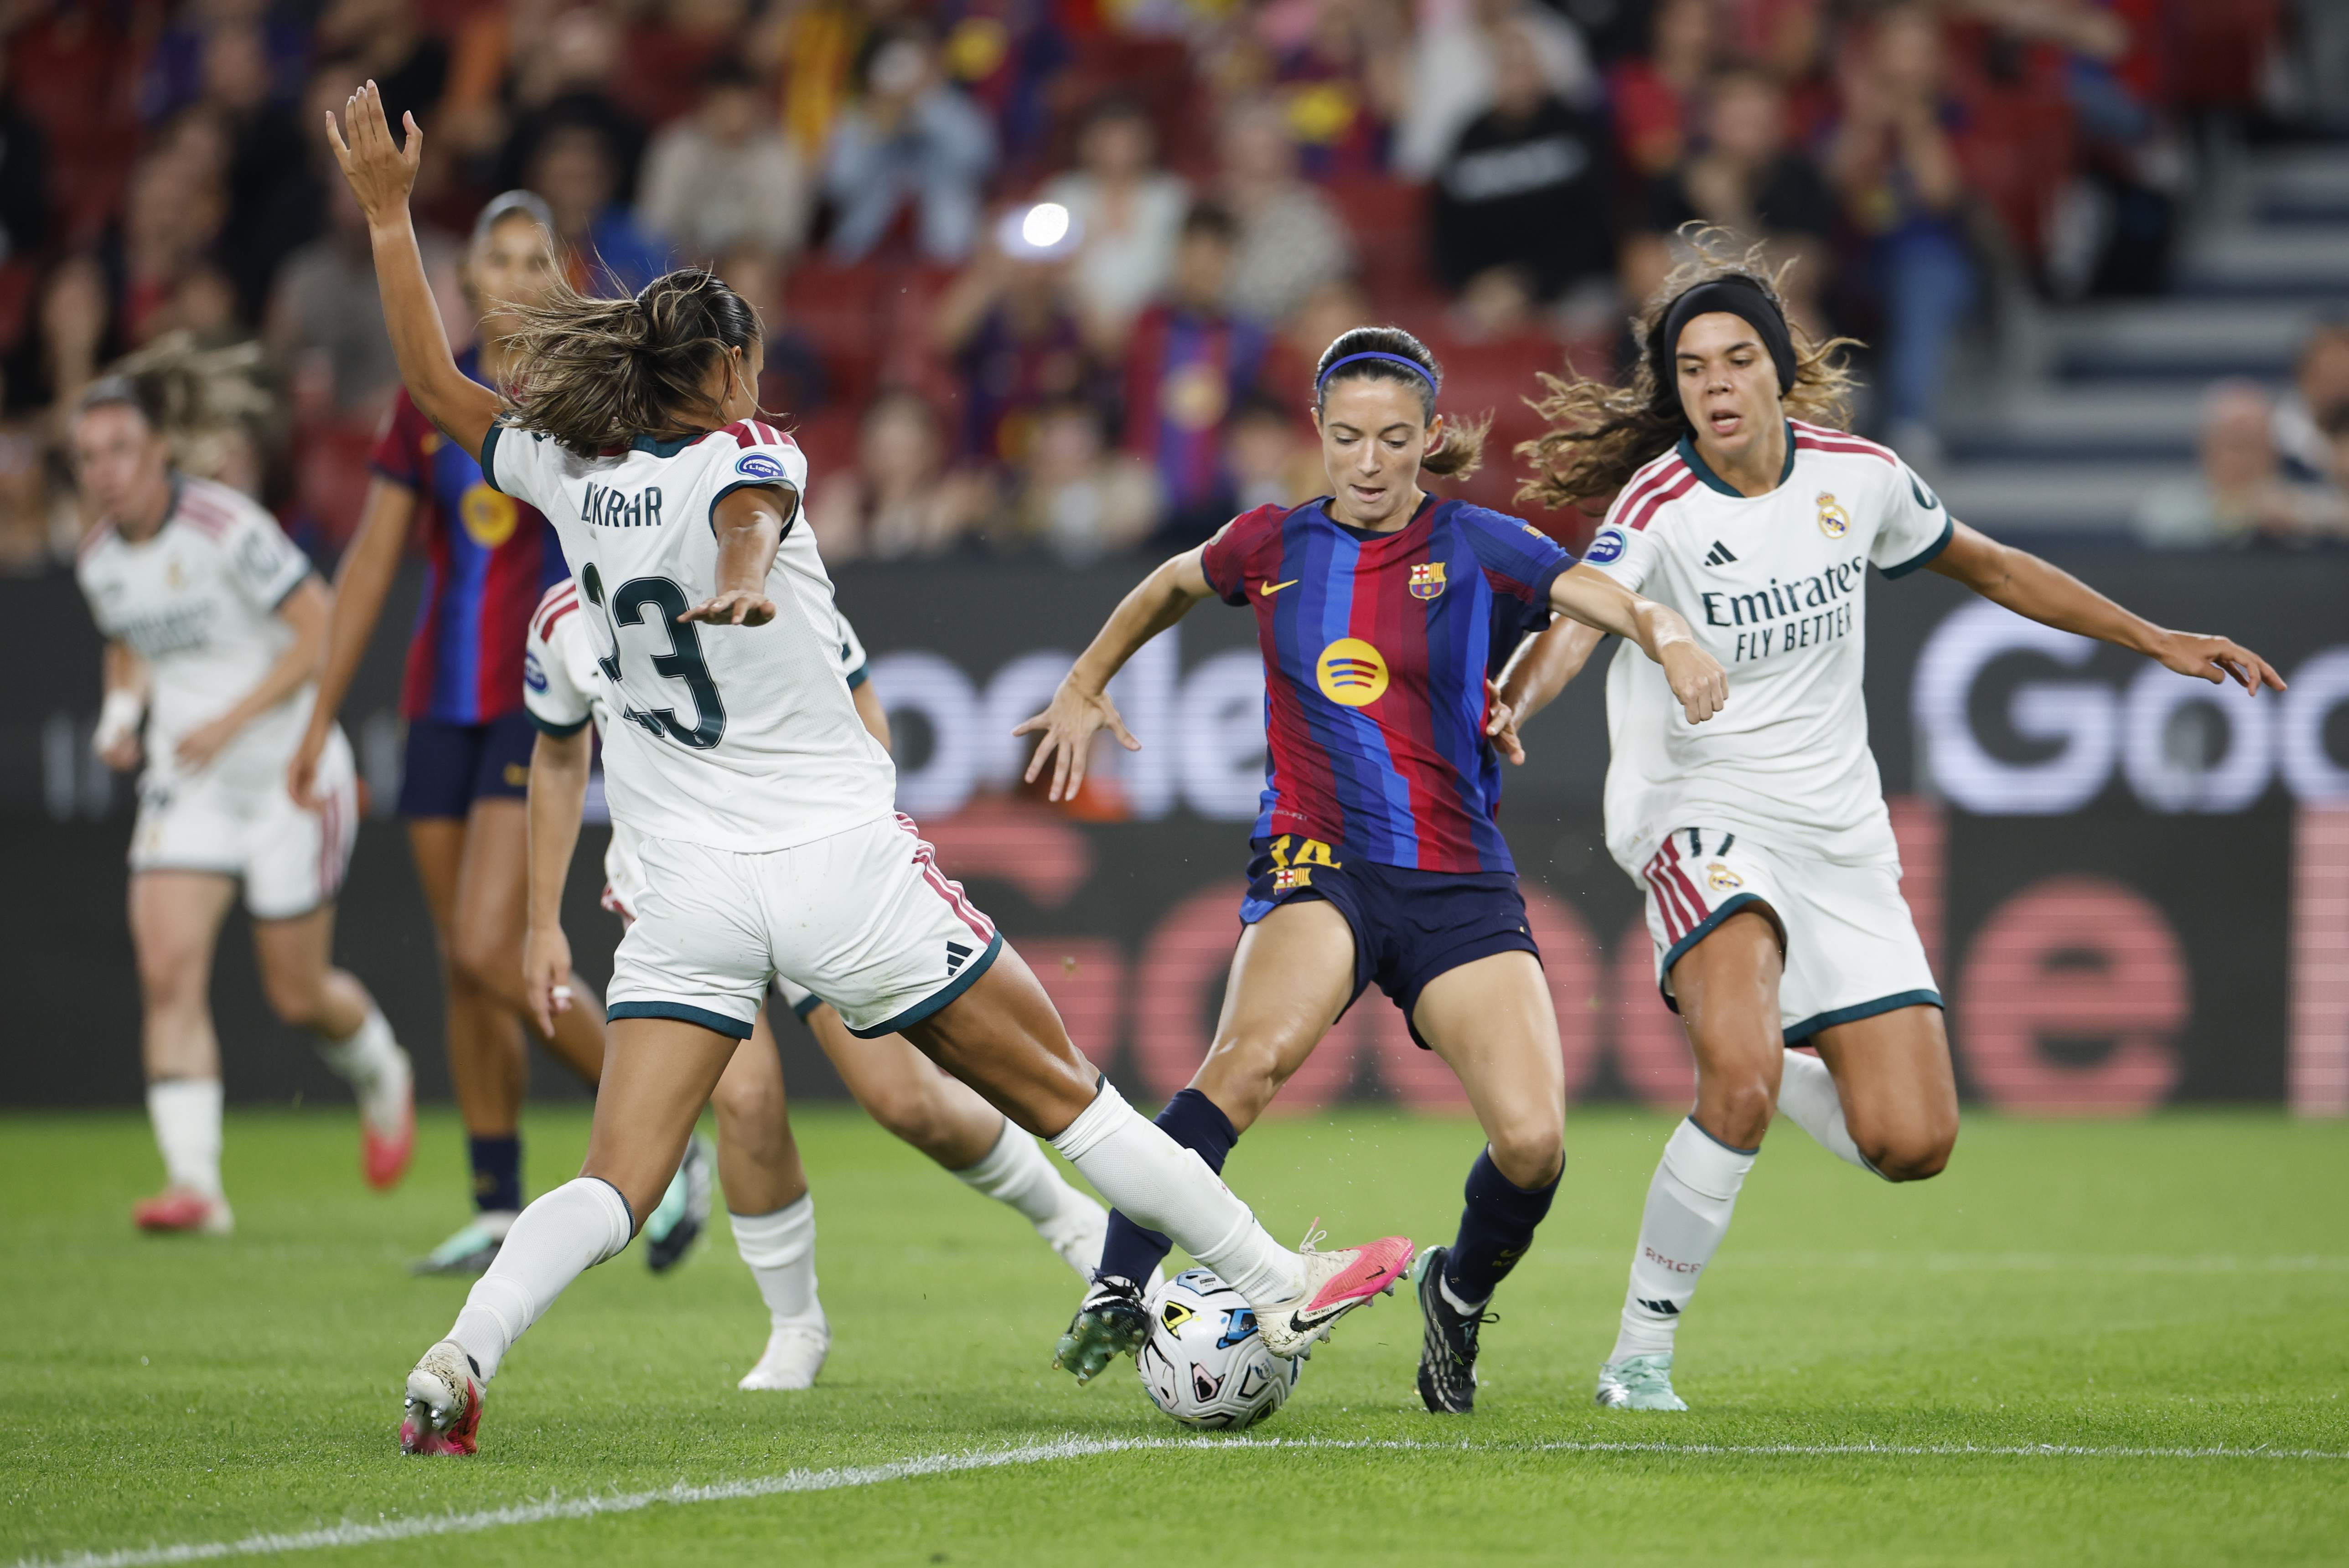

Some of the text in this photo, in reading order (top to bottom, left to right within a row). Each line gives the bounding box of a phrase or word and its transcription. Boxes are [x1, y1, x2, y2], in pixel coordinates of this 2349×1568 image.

[749, 464, 771, 474] Liga
[581, 481, 662, 527] LKRAR
[1701, 557, 1862, 627] Emirates
[1735, 602, 1852, 662] FLY BETTER
